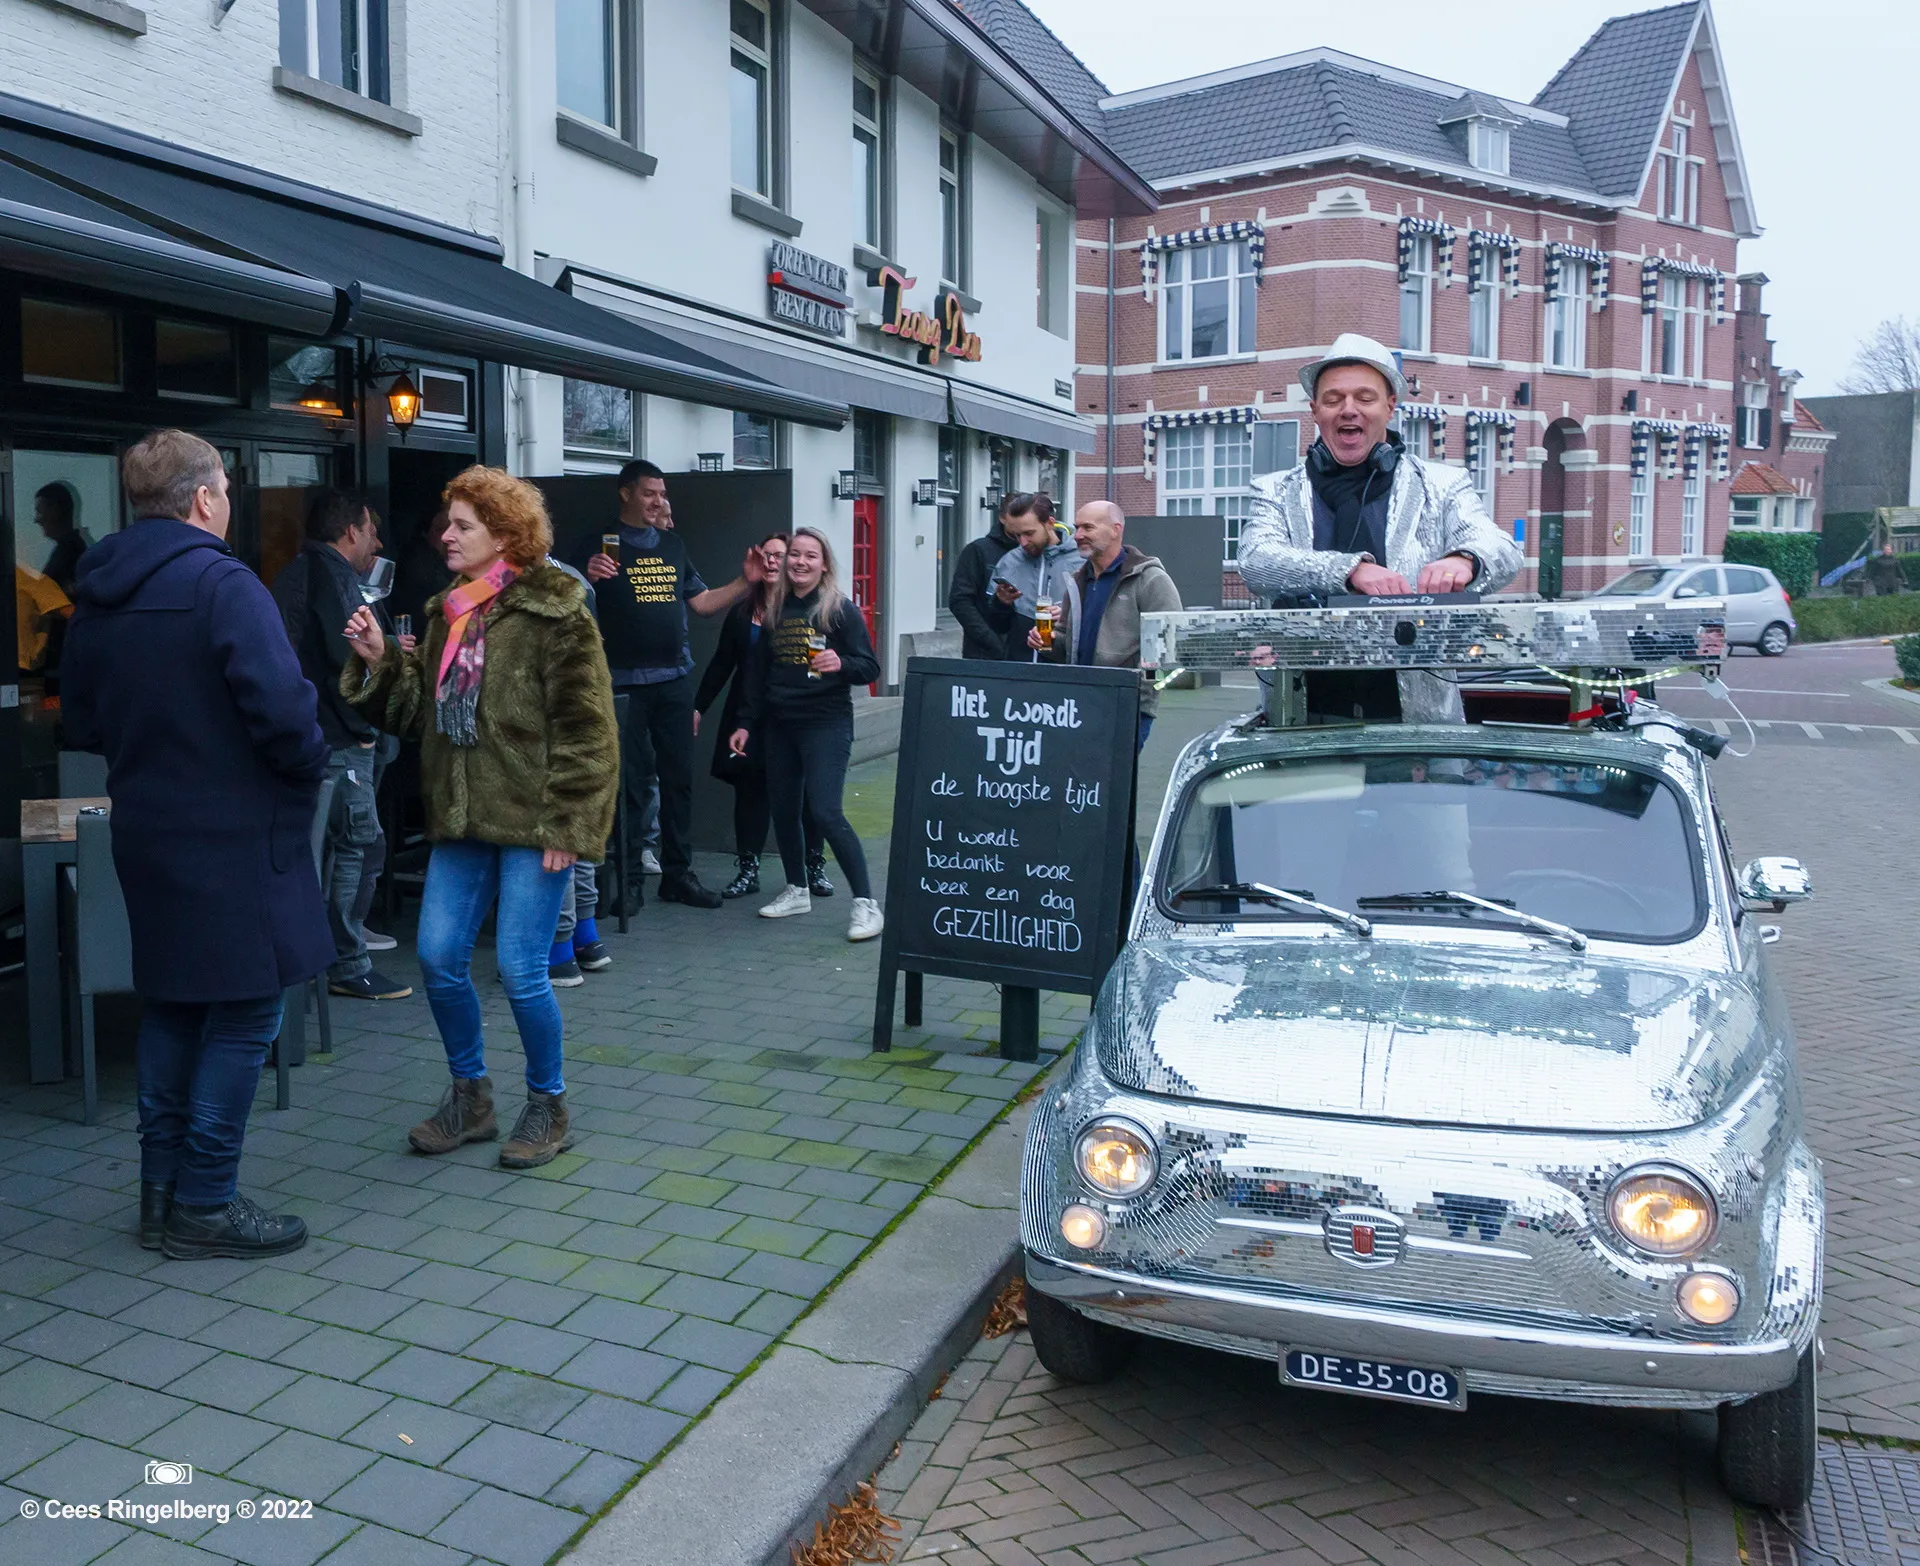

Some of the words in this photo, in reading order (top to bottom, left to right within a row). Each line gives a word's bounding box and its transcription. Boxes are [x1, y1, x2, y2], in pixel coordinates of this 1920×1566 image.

[626, 565, 676, 575] BRUISEND
[635, 557, 664, 565] GEEN
[629, 574, 678, 584] CENTRUM
[634, 584, 675, 593] ZONDER
[635, 594, 677, 603] HORECA
[1368, 596, 1419, 605] Pioneer
[976, 726, 1043, 776] Tijd
[930, 772, 964, 797] de
[976, 773, 1052, 809] hoogste
[1065, 777, 1101, 814] tijd
[926, 819, 943, 842] U
[926, 847, 1005, 873] bedankt
[985, 886, 1019, 903] een
[1040, 892, 1075, 921] dag
[932, 906, 1083, 952] GEZELLIGHEID
[1300, 1353, 1449, 1398] DE-55-08
